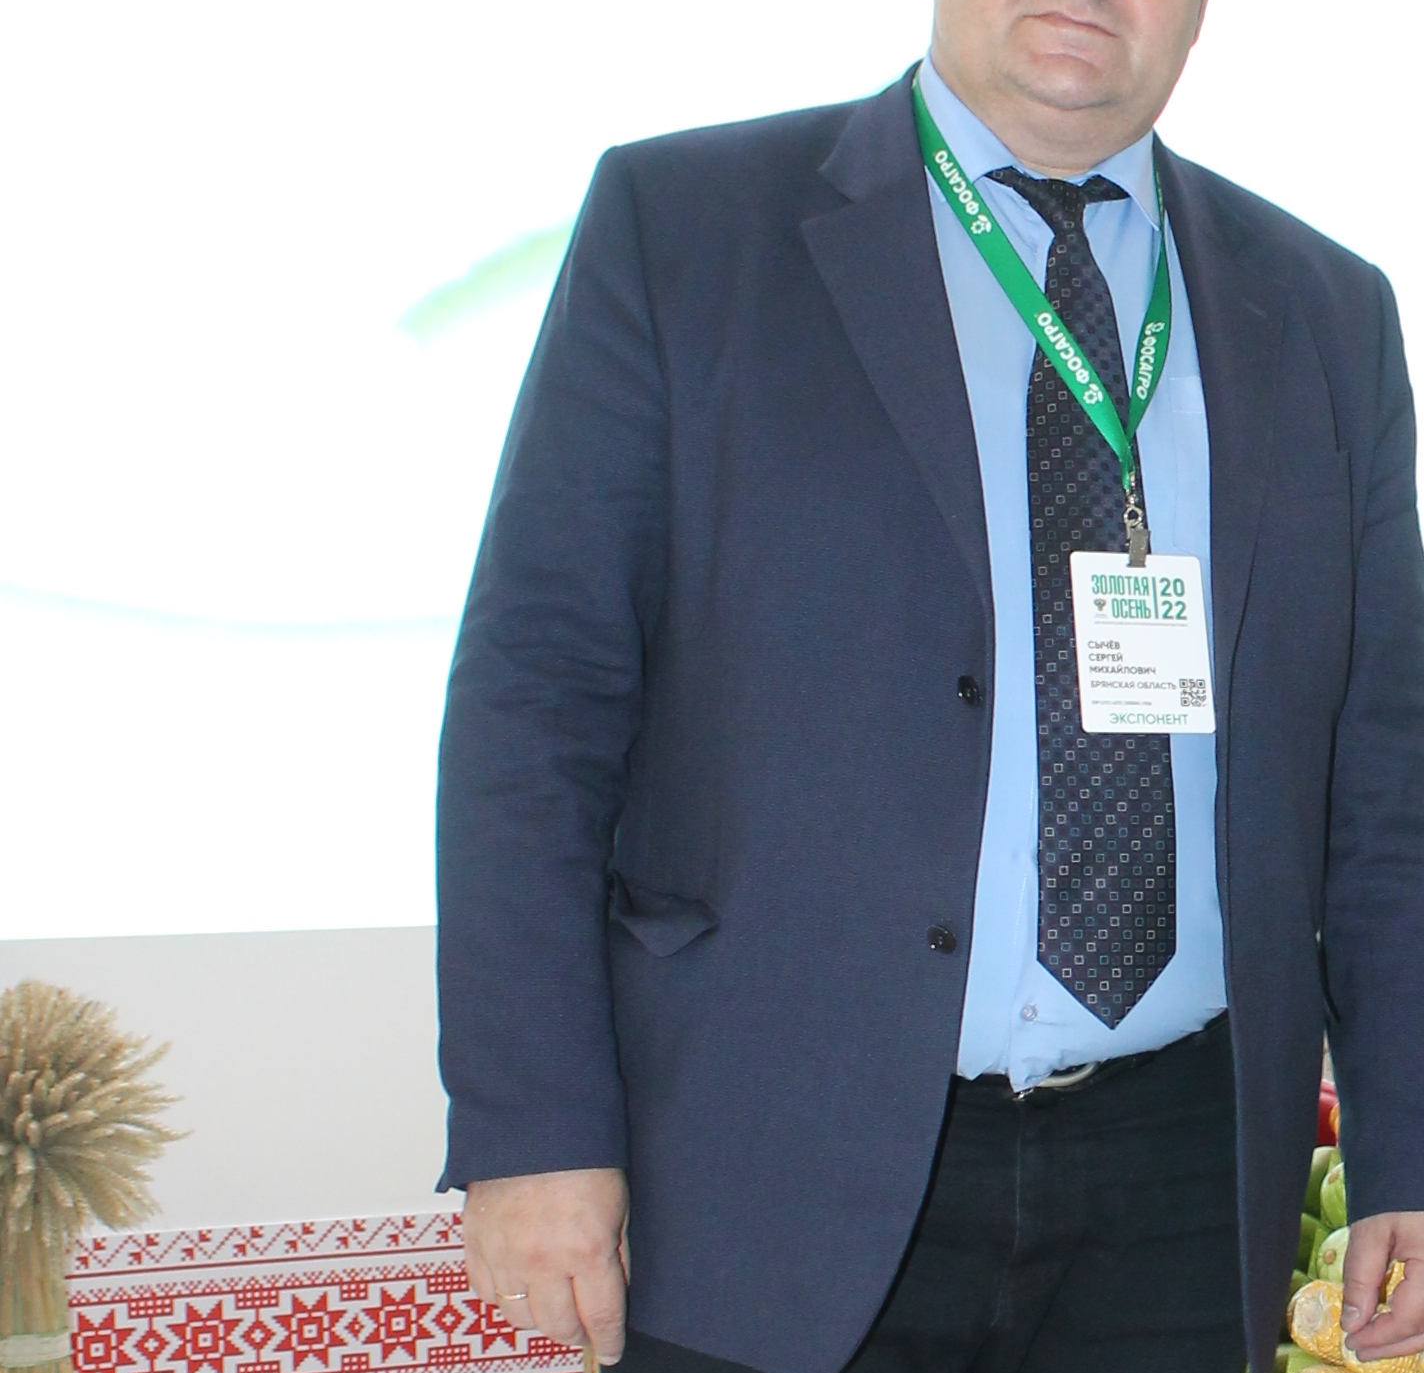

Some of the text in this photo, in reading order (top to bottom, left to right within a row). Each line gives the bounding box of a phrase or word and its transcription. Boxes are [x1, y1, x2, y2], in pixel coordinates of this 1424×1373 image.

[933, 149, 980, 217] ФОСАГРО
[1037, 311, 1090, 385] ФОСАГРО
[1136, 336, 1157, 400] ФОСАГРО
[1091, 574, 1185, 597] ЗОЛОТАЯ 20
[1111, 598, 1188, 620] ОСЕНЬ 22
[1087, 640, 1120, 650] СЫЧЁВ
[1088, 652, 1123, 662] СЕРГЕЙ
[1089, 664, 1156, 675] МИХАЙЛОВИЧ
[1090, 680, 1177, 690] БРЯНСКАЯ ОБЛАСТЬ
[1108, 713, 1188, 724] ЭКСПОНЕНТ
